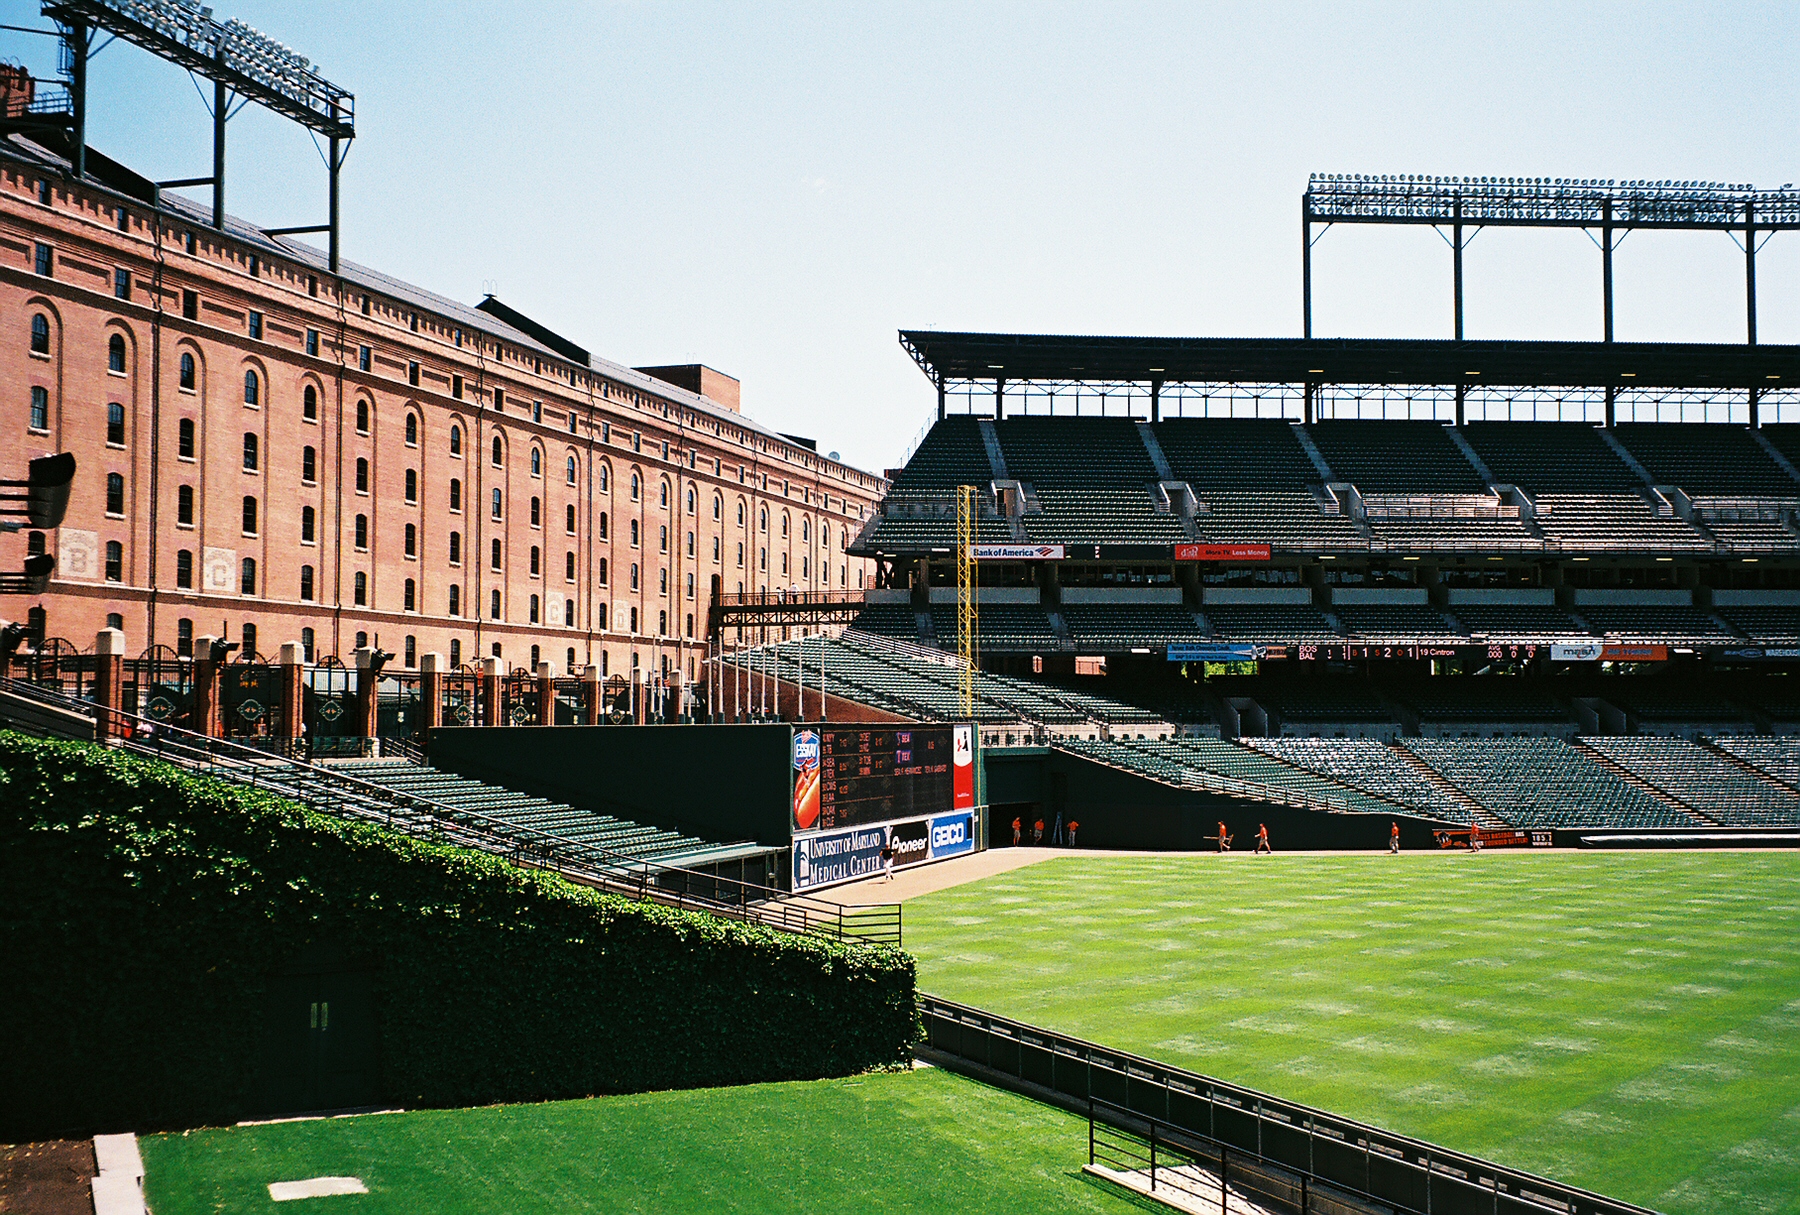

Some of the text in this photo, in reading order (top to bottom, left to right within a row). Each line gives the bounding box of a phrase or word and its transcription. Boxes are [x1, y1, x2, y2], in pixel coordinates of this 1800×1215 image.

[973, 547, 1034, 557] Bank of America
[1299, 645, 1318, 653] BOS
[1362, 647, 1369, 658] 1
[1384, 647, 1392, 658] 2
[1407, 647, 1413, 658] 1
[1429, 648, 1455, 657] Cintron
[1299, 652, 1316, 660] BAL
[1510, 651, 1517, 659] 0
[1527, 651, 1534, 659] 0
[932, 822, 965, 849] GEICO
[809, 831, 881, 860] UNIVERSITY OF MARYLAND
[891, 835, 928, 855] Pioneer
[809, 855, 881, 886] MEDICAL CENTER
